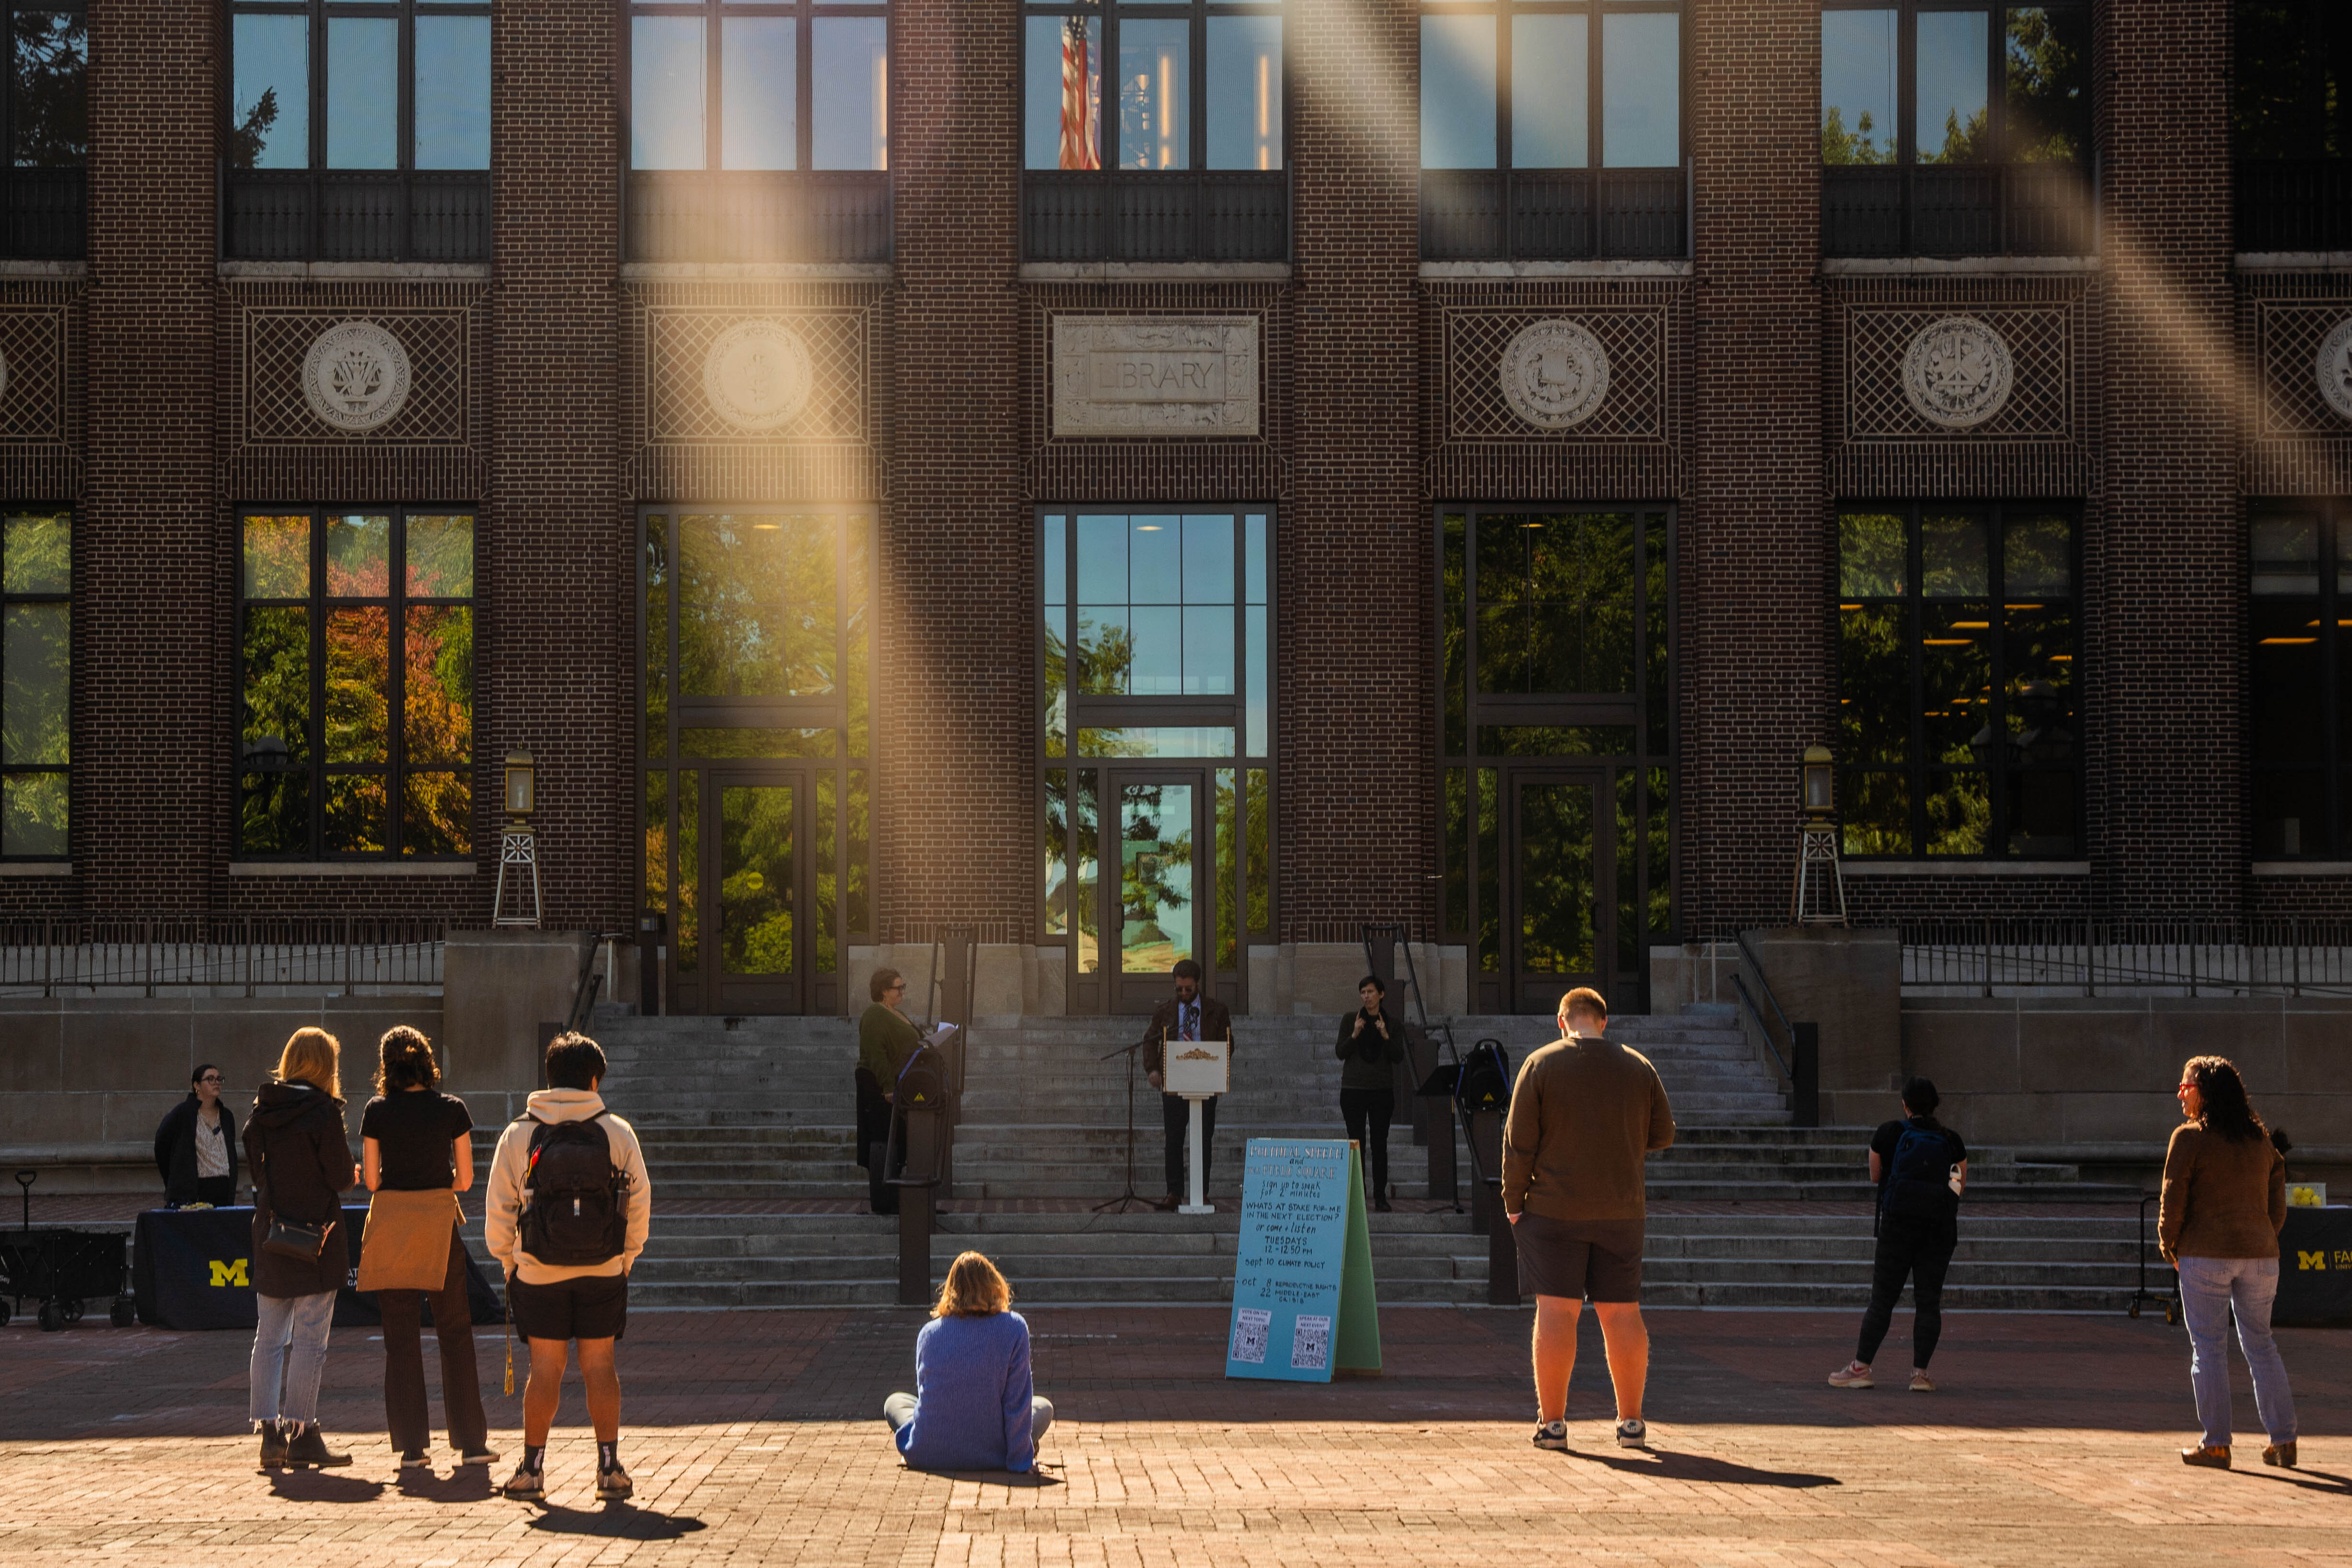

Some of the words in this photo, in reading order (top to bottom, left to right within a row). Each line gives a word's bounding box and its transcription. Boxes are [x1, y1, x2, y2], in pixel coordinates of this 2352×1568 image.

[1099, 362, 1214, 388] LIBRARY
[1250, 1145, 1300, 1158] POLITICAL
[1303, 1146, 1344, 1160] SPEECH
[1263, 1164, 1292, 1177] PUBLIC
[1296, 1166, 1337, 1179] SQUARE
[1281, 1181, 1289, 1190] up
[1292, 1180, 1299, 1189] to
[1301, 1181, 1321, 1190] speak
[1260, 1189, 1273, 1199] for
[1280, 1188, 1285, 1197] 2
[1290, 1190, 1320, 1198] minutes
[1246, 1201, 1273, 1210] WHATS
[1288, 1203, 1310, 1212] STAKE
[1256, 1211, 1269, 1220] THE
[1271, 1212, 1292, 1220] NEXT
[1266, 1224, 1283, 1233] come
[1265, 1236, 1308, 1245] TUESDAYS
[1266, 1257, 1274, 1266] 10
[1304, 1261, 1325, 1270] POLICY
[2297, 1251, 2326, 1270] M
[209, 1258, 249, 1287] M
[1266, 1278, 1272, 1288] 8
[1275, 1281, 1313, 1289] REPRODUCTIVE
[1315, 1283, 1337, 1291] RIGHTS
[1260, 1288, 1271, 1298] 22
[1279, 1296, 1304, 1304] CRISIS
